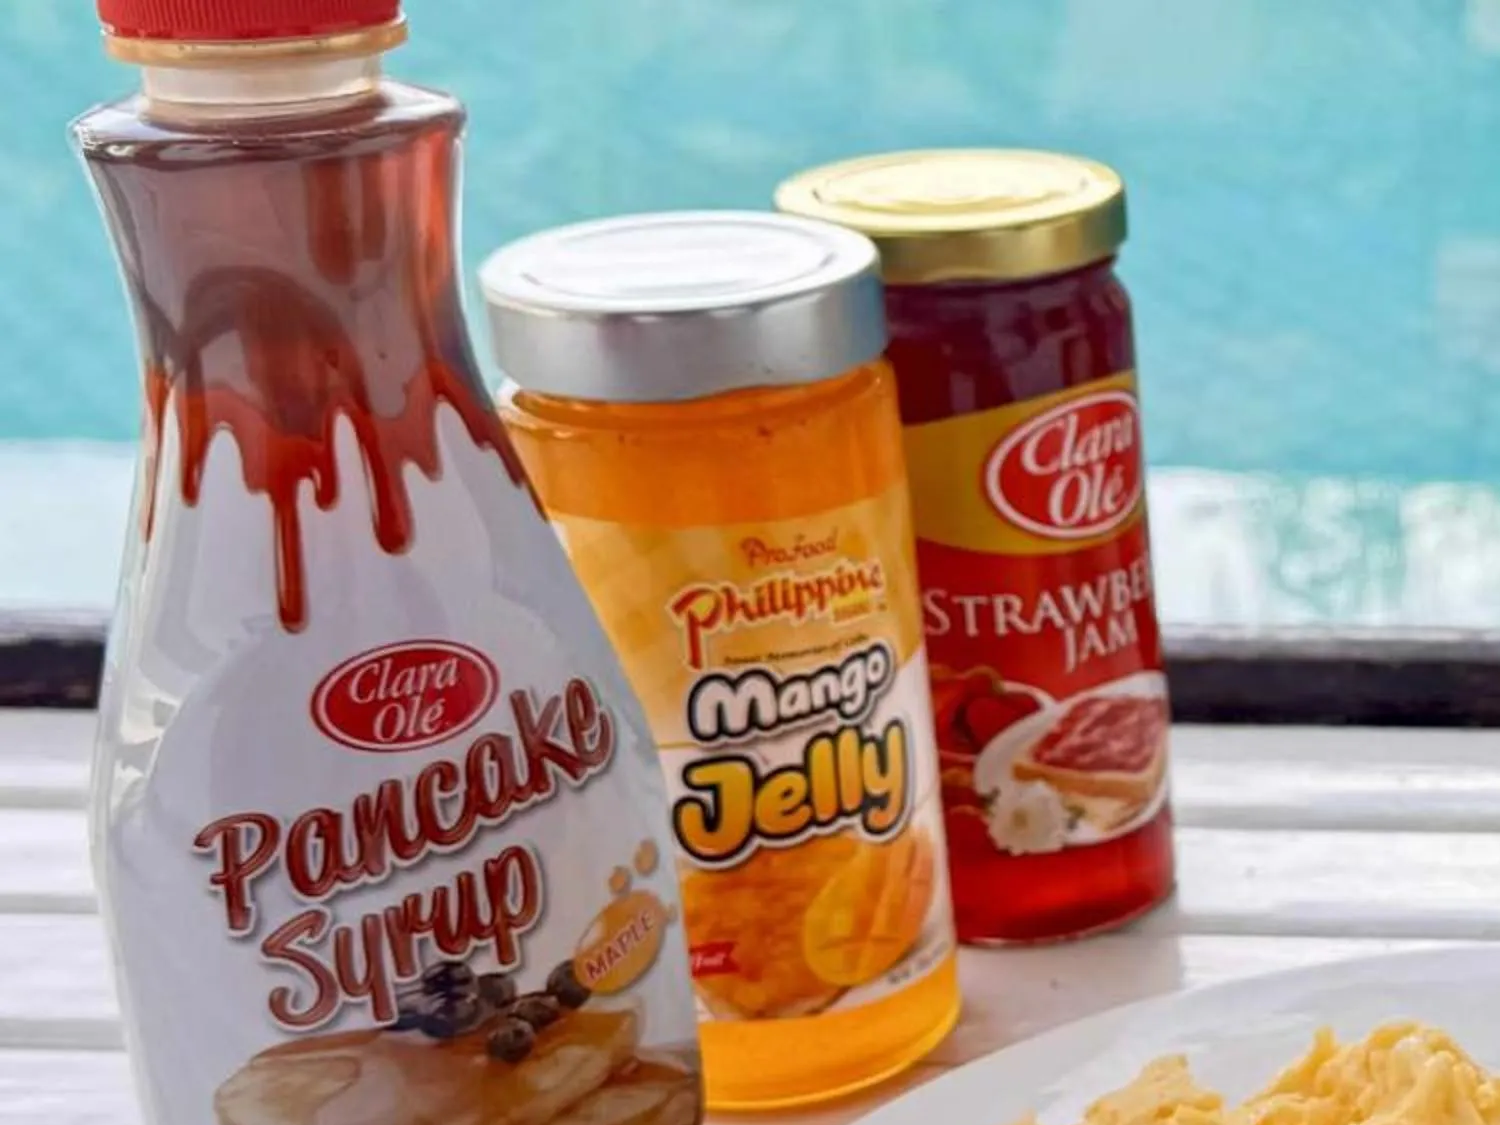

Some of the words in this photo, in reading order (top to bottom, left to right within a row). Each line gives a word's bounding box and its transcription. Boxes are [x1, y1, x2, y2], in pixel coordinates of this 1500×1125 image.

[1019, 408, 1136, 476] Clara
[1049, 465, 1125, 527] Olé
[672, 561, 883, 669] Philippine
[1063, 608, 1139, 674] JAM
[350, 656, 458, 704] Clara
[690, 645, 890, 742] Mango
[373, 698, 446, 743] Olé
[193, 677, 614, 931] Pancake
[674, 722, 910, 862] Jelly
[262, 845, 540, 1028] Syrup
[585, 910, 655, 980] MAPLE
